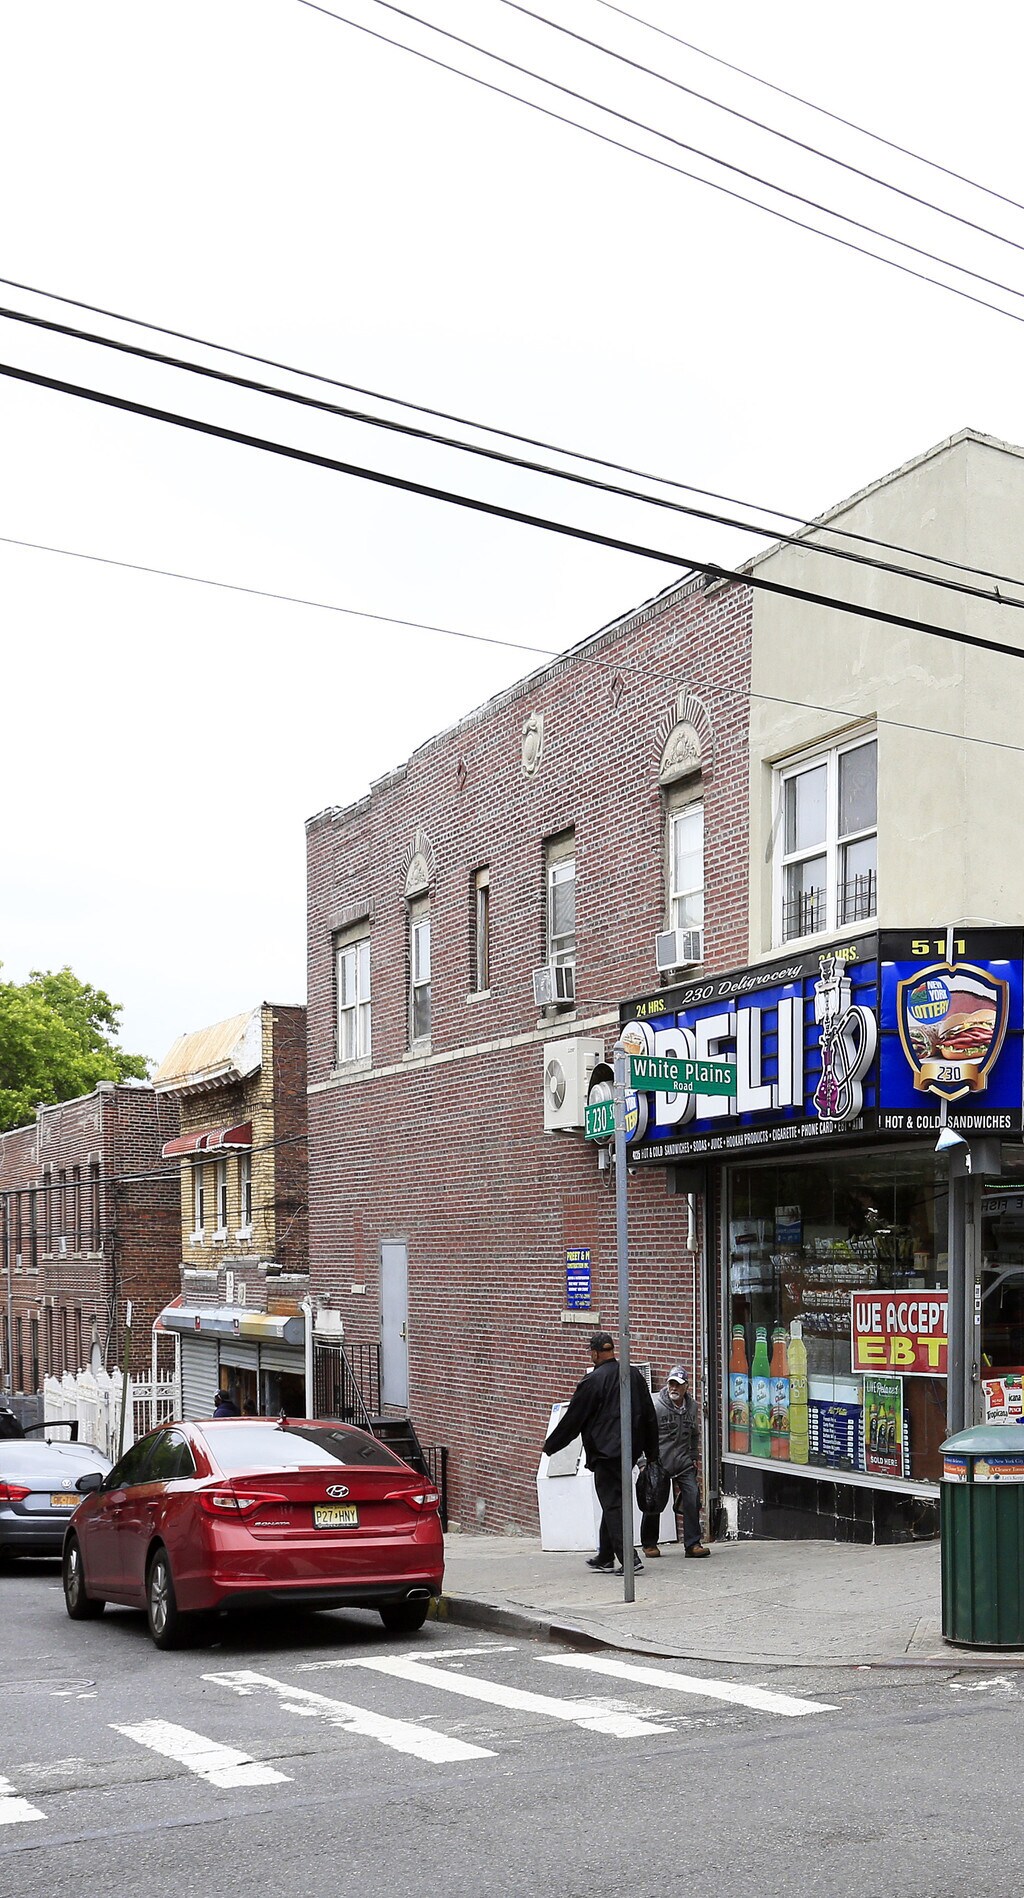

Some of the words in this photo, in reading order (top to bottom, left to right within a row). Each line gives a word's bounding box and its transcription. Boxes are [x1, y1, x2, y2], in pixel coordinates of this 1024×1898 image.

[912, 939, 966, 955] 511
[682, 985, 713, 1004] 230
[718, 963, 802, 996] Deligrocery
[927, 981, 943, 990] NEW
[929, 990, 948, 1001] YORK
[636, 1005, 646, 1018] 24
[648, 999, 666, 1014] HRS.
[911, 1000, 949, 1019] LOTTERY
[633, 1057, 678, 1079] White
[685, 1062, 731, 1084] Plains
[655, 997, 803, 1126] DELI
[936, 1065, 961, 1081] 230
[674, 1081, 693, 1091] Road
[586, 1110, 590, 1134] E
[593, 1106, 607, 1133] 230
[885, 1115, 903, 1129] HOT
[906, 1116, 913, 1128] &
[916, 1115, 941, 1128] COLD
[947, 1115, 1011, 1129] SANDWICHES
[653, 1145, 663, 1157] COLD
[664, 1142, 690, 1155] SANDWICHES
[693, 1139, 707, 1152] SODAS
[710, 1137, 723, 1150] JUICE
[726, 1134, 744, 1148] HOOKAH
[744, 1130, 768, 1145] PRODUCTS
[772, 1126, 797, 1141] CIGARETTE
[801, 1122, 819, 1137] PHONE
[820, 1120, 833, 1134] CARD
[856, 1302, 882, 1333] WE
[886, 1302, 948, 1334] ACCEPT
[857, 1336, 948, 1367] EBT
[987, 1408, 1008, 1420] Tropicana
[870, 1455, 884, 1465] SOLD
[884, 1458, 898, 1467] HERE
